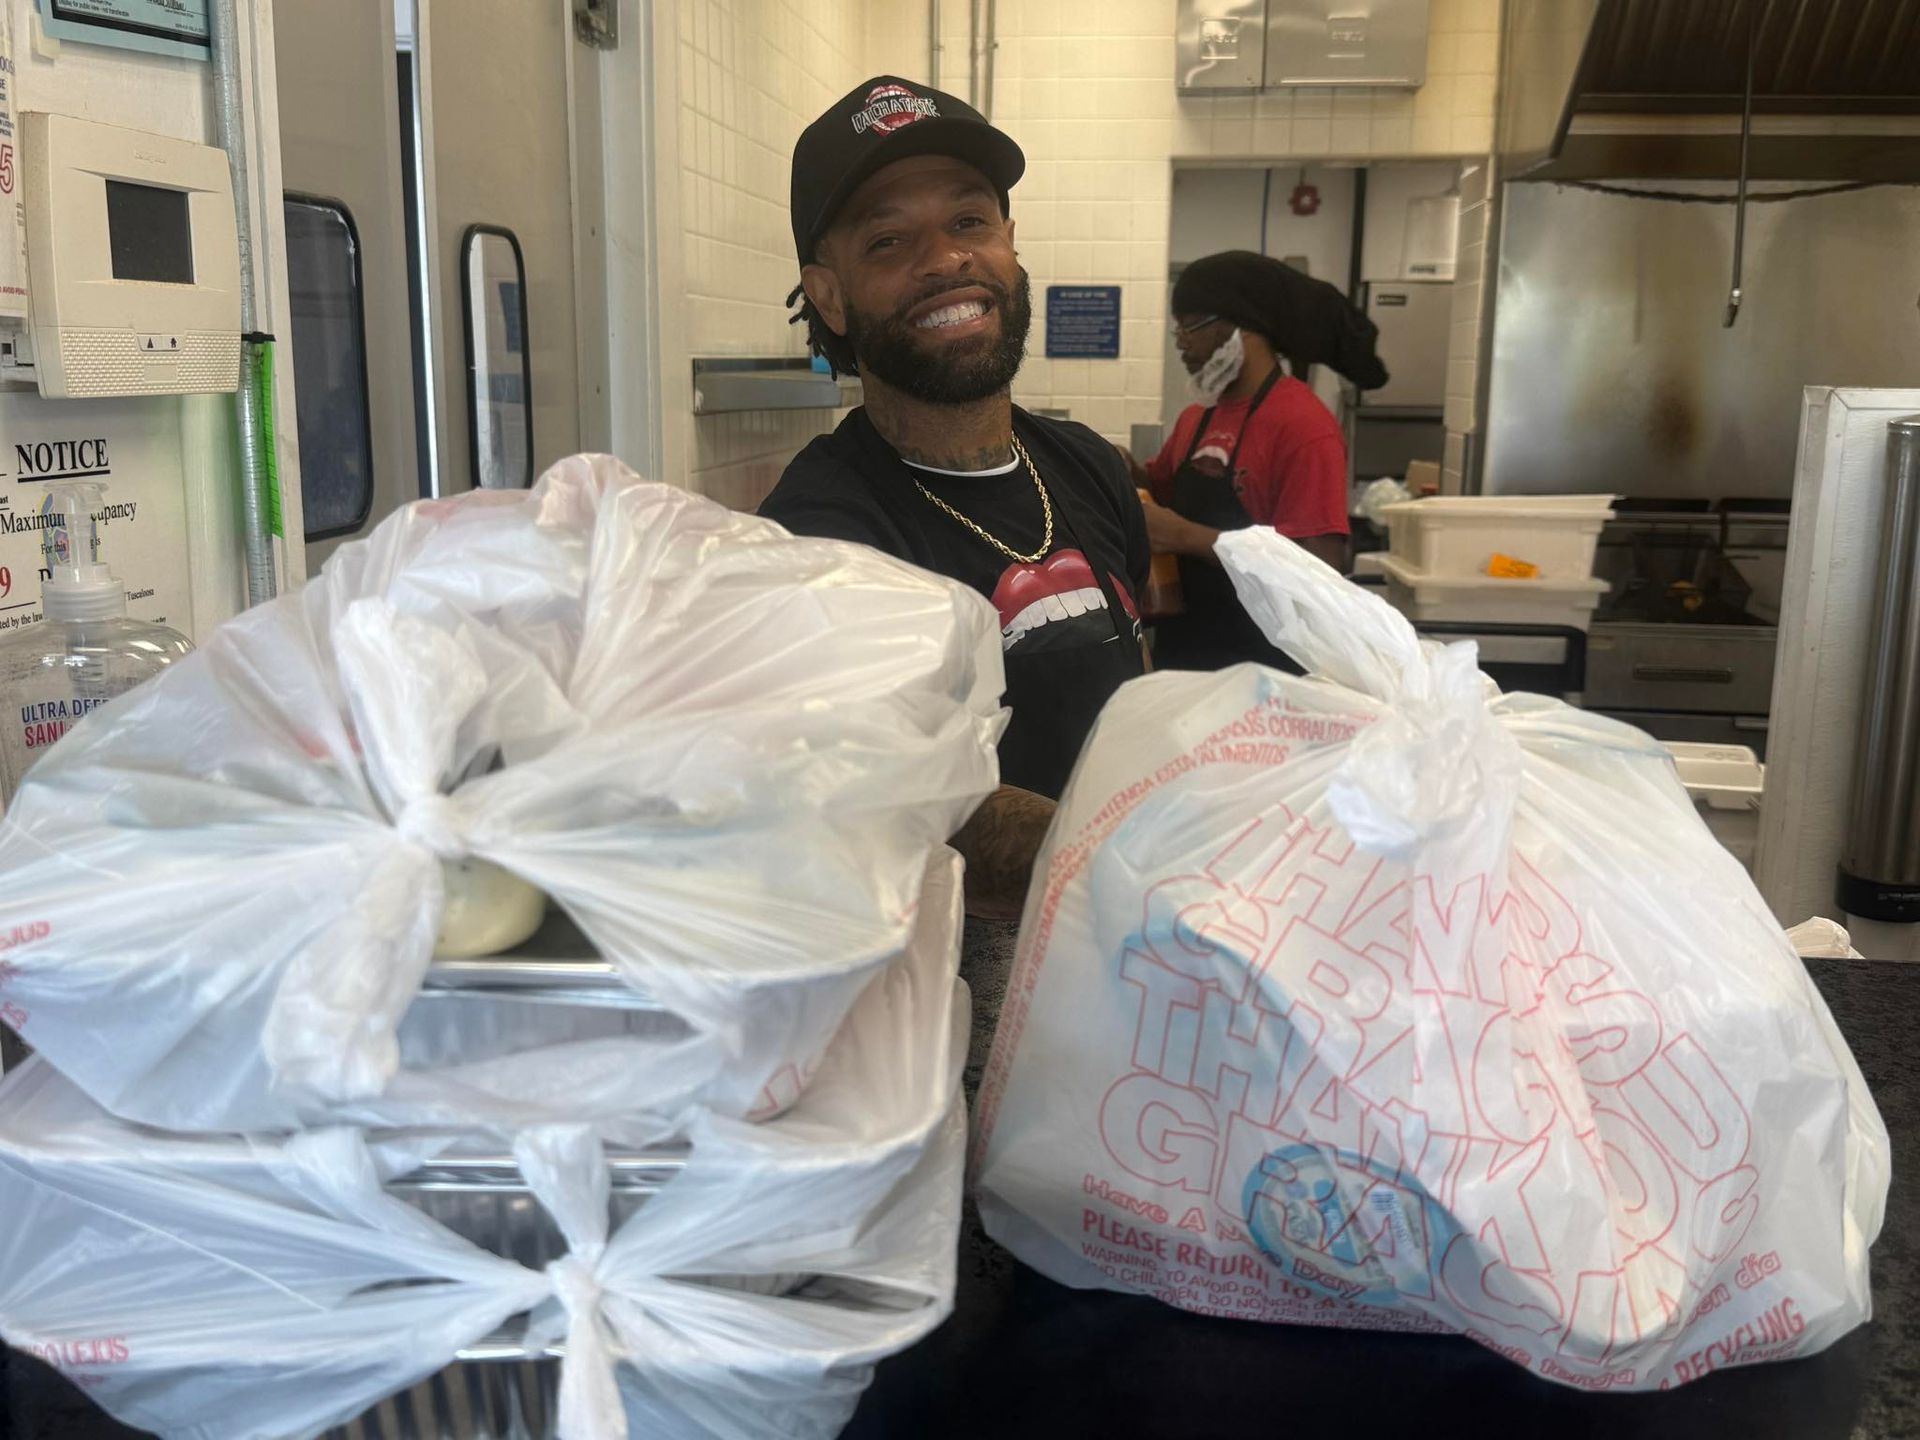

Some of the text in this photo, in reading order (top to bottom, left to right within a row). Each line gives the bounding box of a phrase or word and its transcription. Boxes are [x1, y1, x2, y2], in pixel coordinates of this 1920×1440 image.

[851, 102, 891, 134] CATCH
[890, 99, 901, 113] A
[15, 438, 109, 475] NOTICE
[11, 616, 20, 630] by
[21, 613, 31, 625] the
[33, 610, 43, 622] law
[21, 700, 67, 724] ULTRA
[24, 720, 66, 748] SANI
[1082, 1208, 1170, 1262] PLEASE
[1176, 1242, 1270, 1291] RETURN
[1279, 1279, 1312, 1300] TO
[1083, 1173, 1170, 1225] Have
[1177, 1206, 1208, 1233] A
[1292, 1256, 1368, 1300] Day
[1166, 1269, 1186, 1283] TO
[1190, 1274, 1240, 1295] AVOID
[1674, 1295, 1807, 1385] RECYCLING
